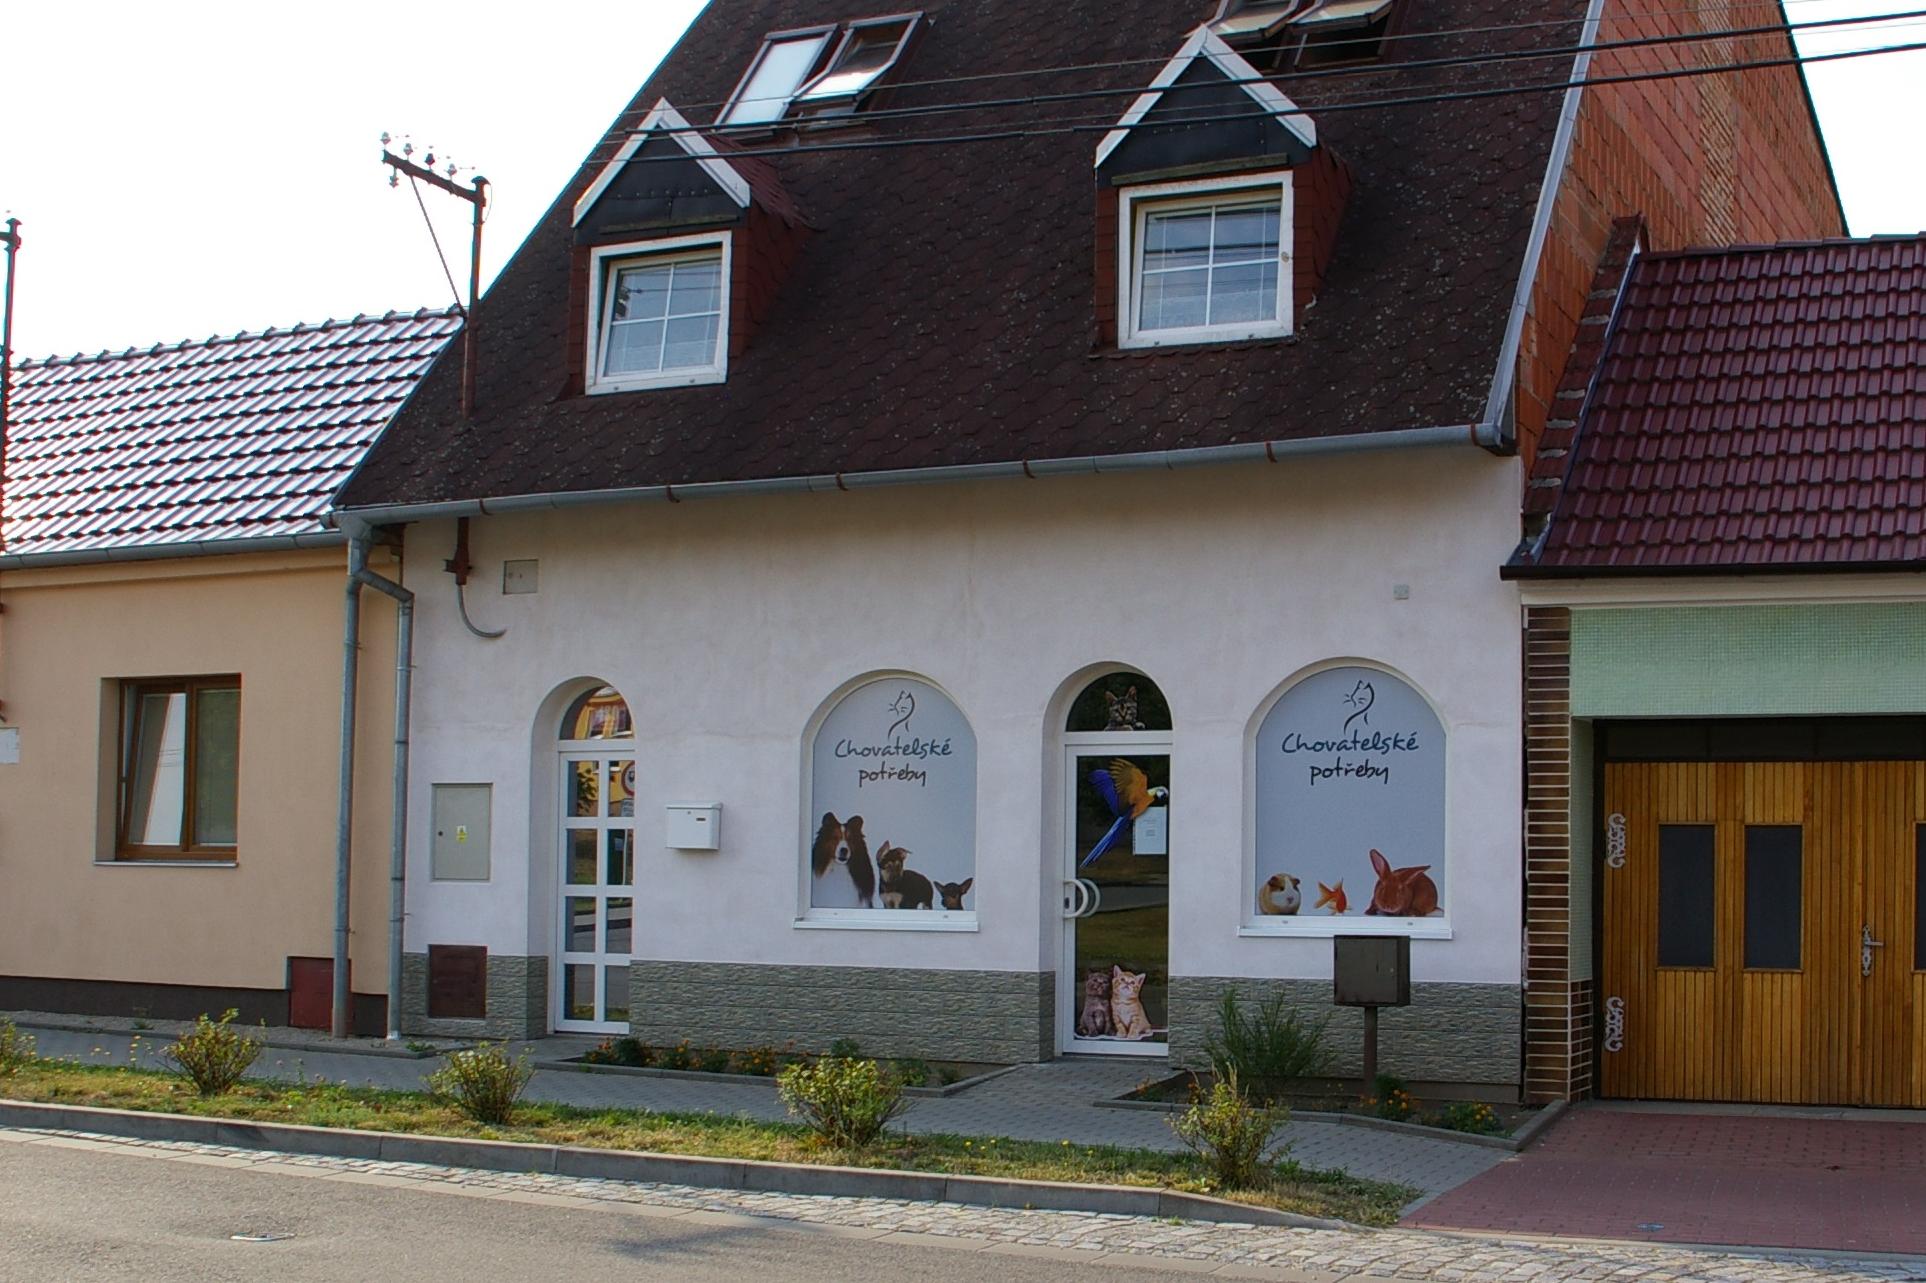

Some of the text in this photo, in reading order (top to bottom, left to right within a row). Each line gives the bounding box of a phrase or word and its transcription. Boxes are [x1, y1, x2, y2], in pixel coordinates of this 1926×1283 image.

[834, 736, 952, 759] Chovatelské
[1281, 729, 1420, 754] Chovatelské
[858, 761, 927, 787] potřeby
[1309, 757, 1389, 785] potřeby
